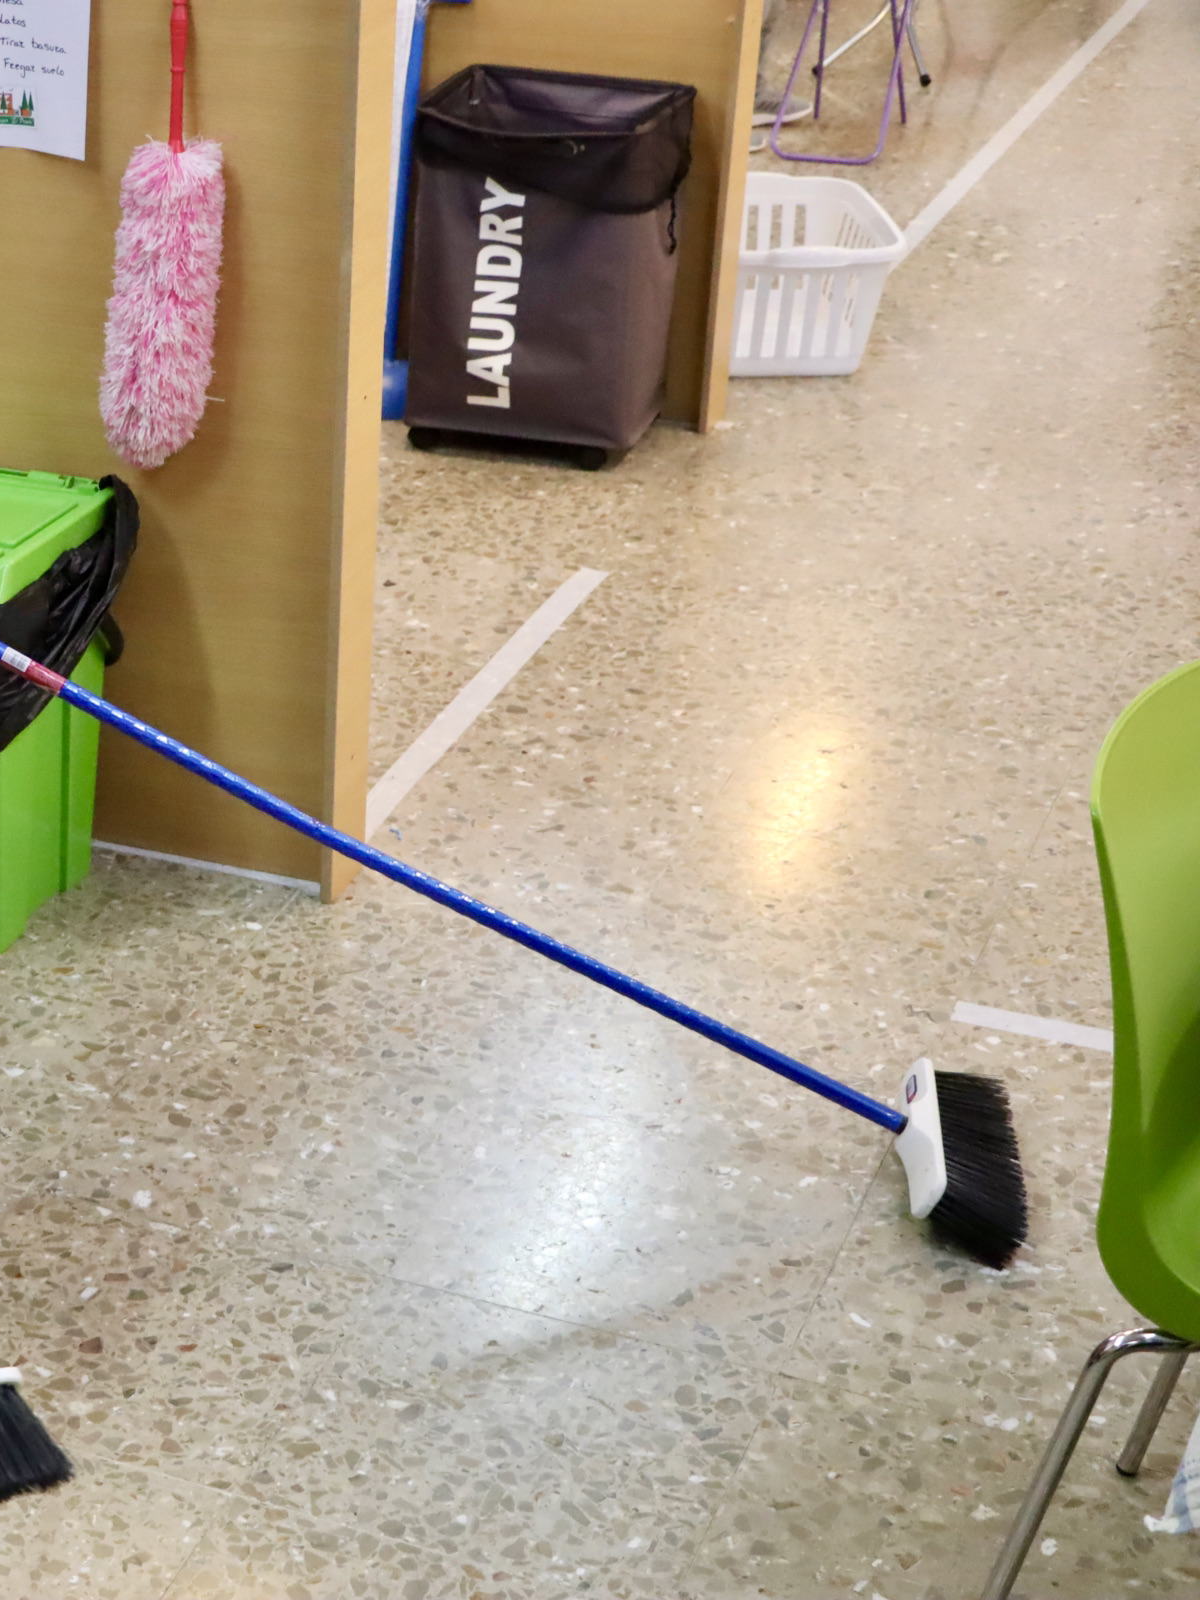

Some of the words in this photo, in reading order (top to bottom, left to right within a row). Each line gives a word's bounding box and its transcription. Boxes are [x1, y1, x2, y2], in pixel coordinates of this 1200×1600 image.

[0, 36, 26, 48] Tirar
[31, 37, 67, 54] basura
[3, 57, 36, 78] Fregar
[41, 65, 65, 76] suelo
[466, 176, 526, 409] LAUNDRY
